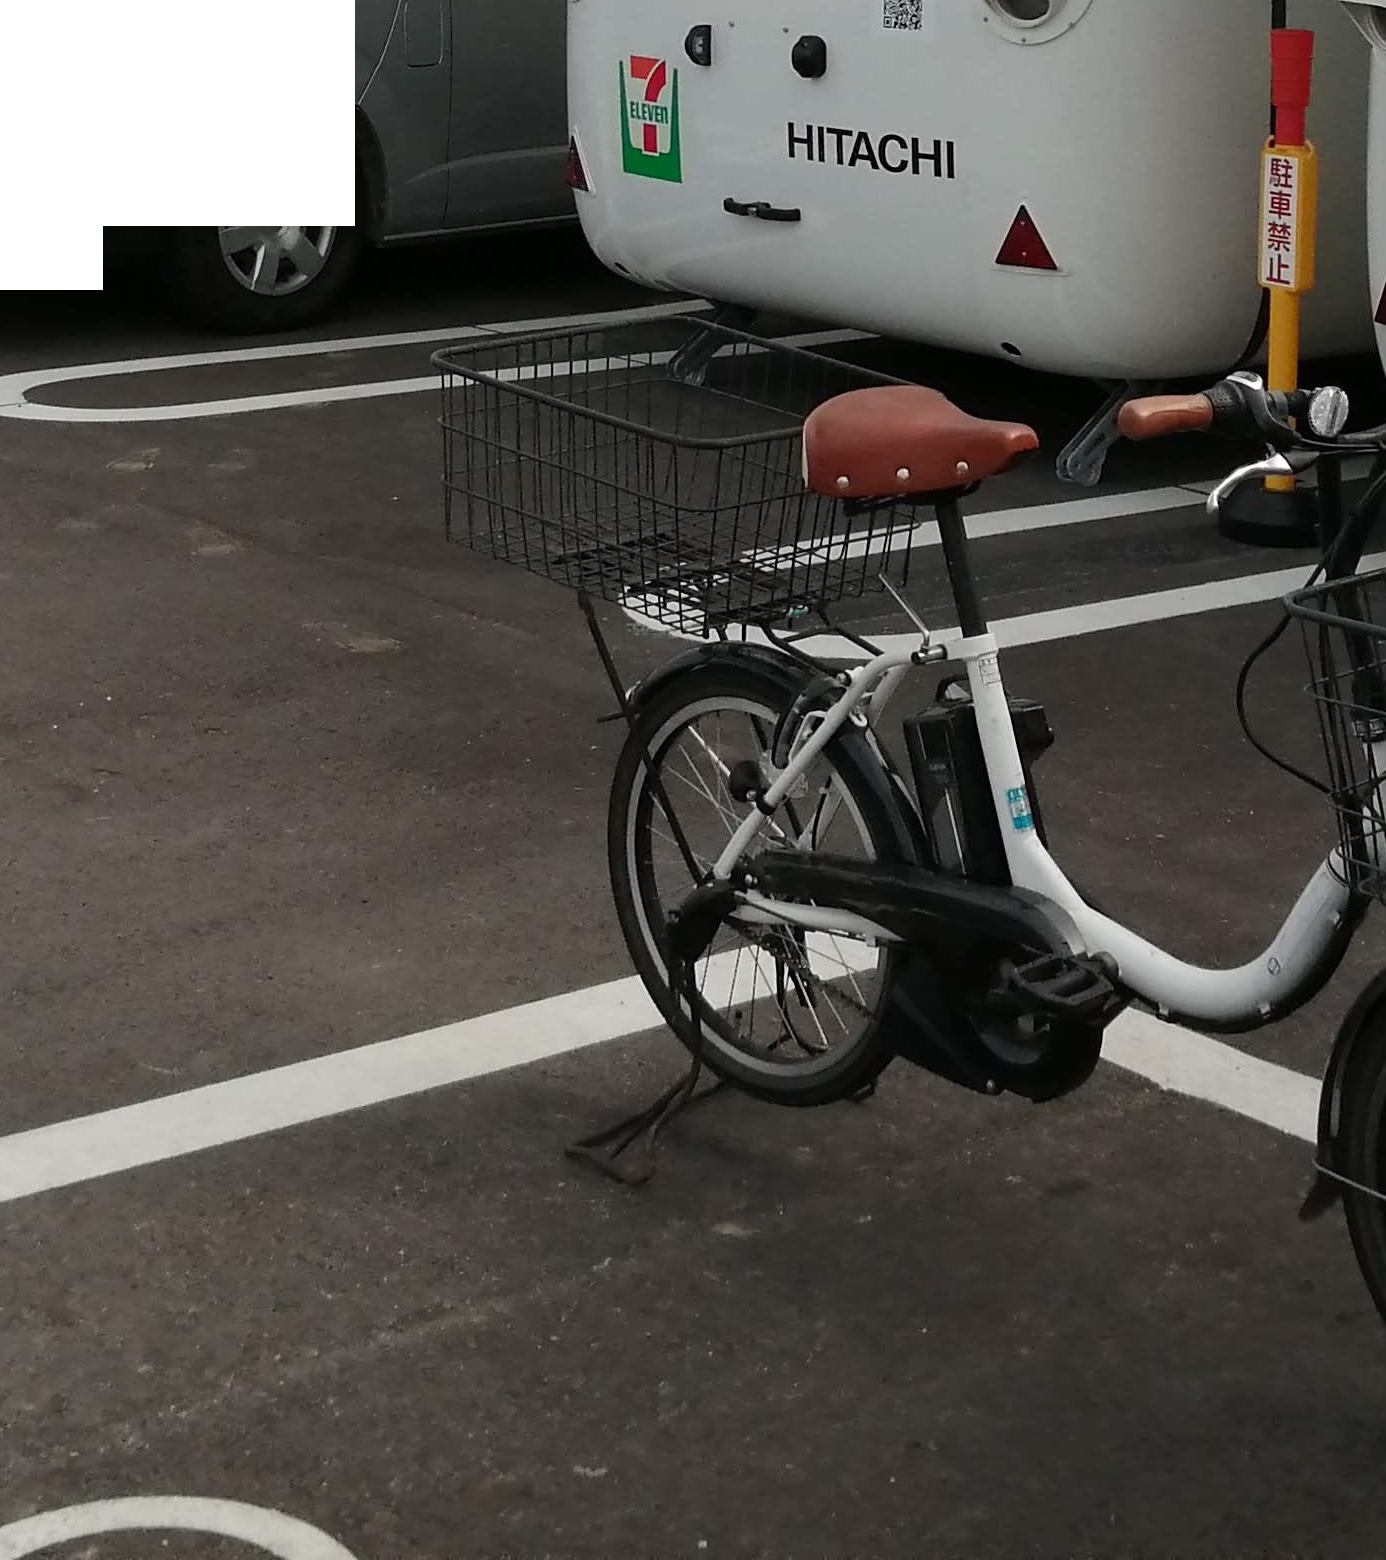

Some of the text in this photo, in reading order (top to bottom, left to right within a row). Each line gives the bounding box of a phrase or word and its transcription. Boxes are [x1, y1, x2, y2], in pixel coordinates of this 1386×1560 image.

[787, 122, 955, 179] HITACHI
[1266, 158, 1293, 286] 駐車禁止
